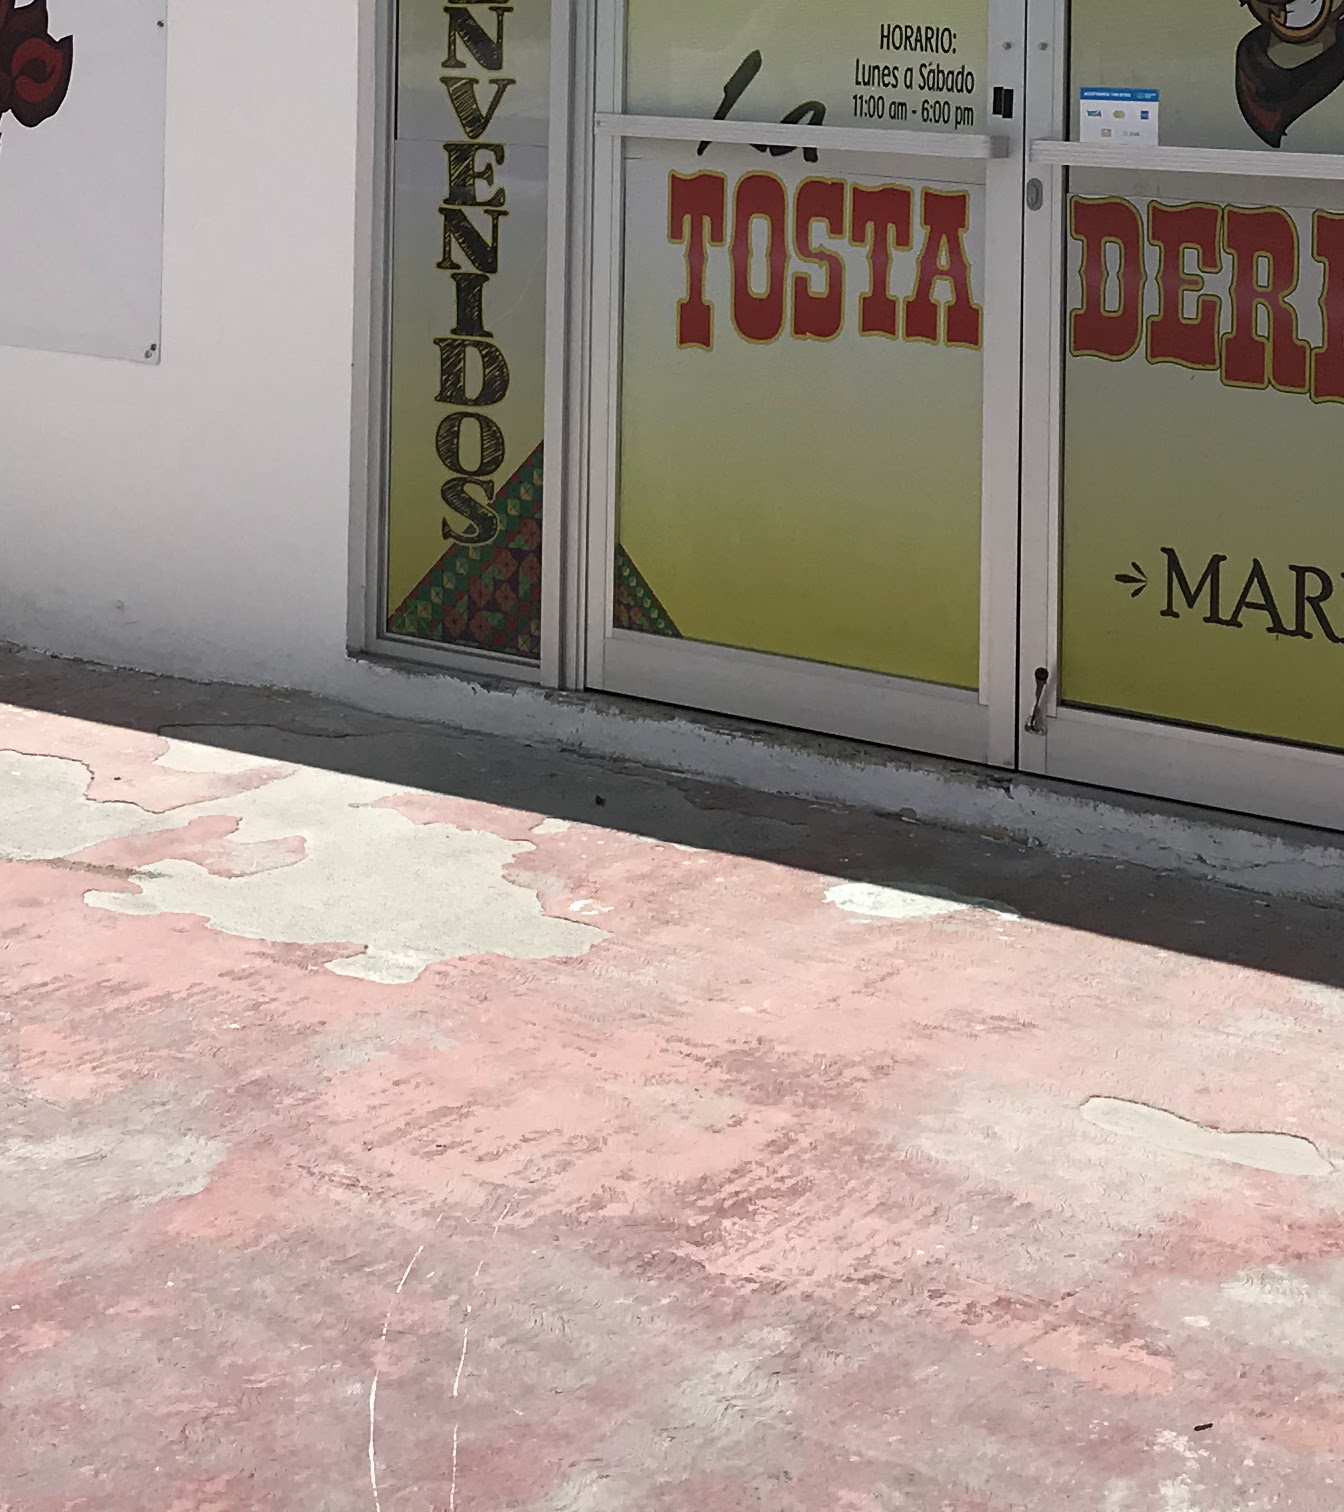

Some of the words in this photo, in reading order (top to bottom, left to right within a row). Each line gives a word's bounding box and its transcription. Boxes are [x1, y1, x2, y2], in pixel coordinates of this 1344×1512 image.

[880, 23, 957, 54] HORARIO:
[855, 58, 899, 89] Lunes
[904, 70, 914, 90] a
[919, 61, 975, 94] Sábado
[852, 94, 886, 120] 11:00
[888, 103, 908, 121] am
[921, 97, 951, 123] 6:00
[955, 107, 974, 129] pm
[667, 170, 983, 352] TOSTA
